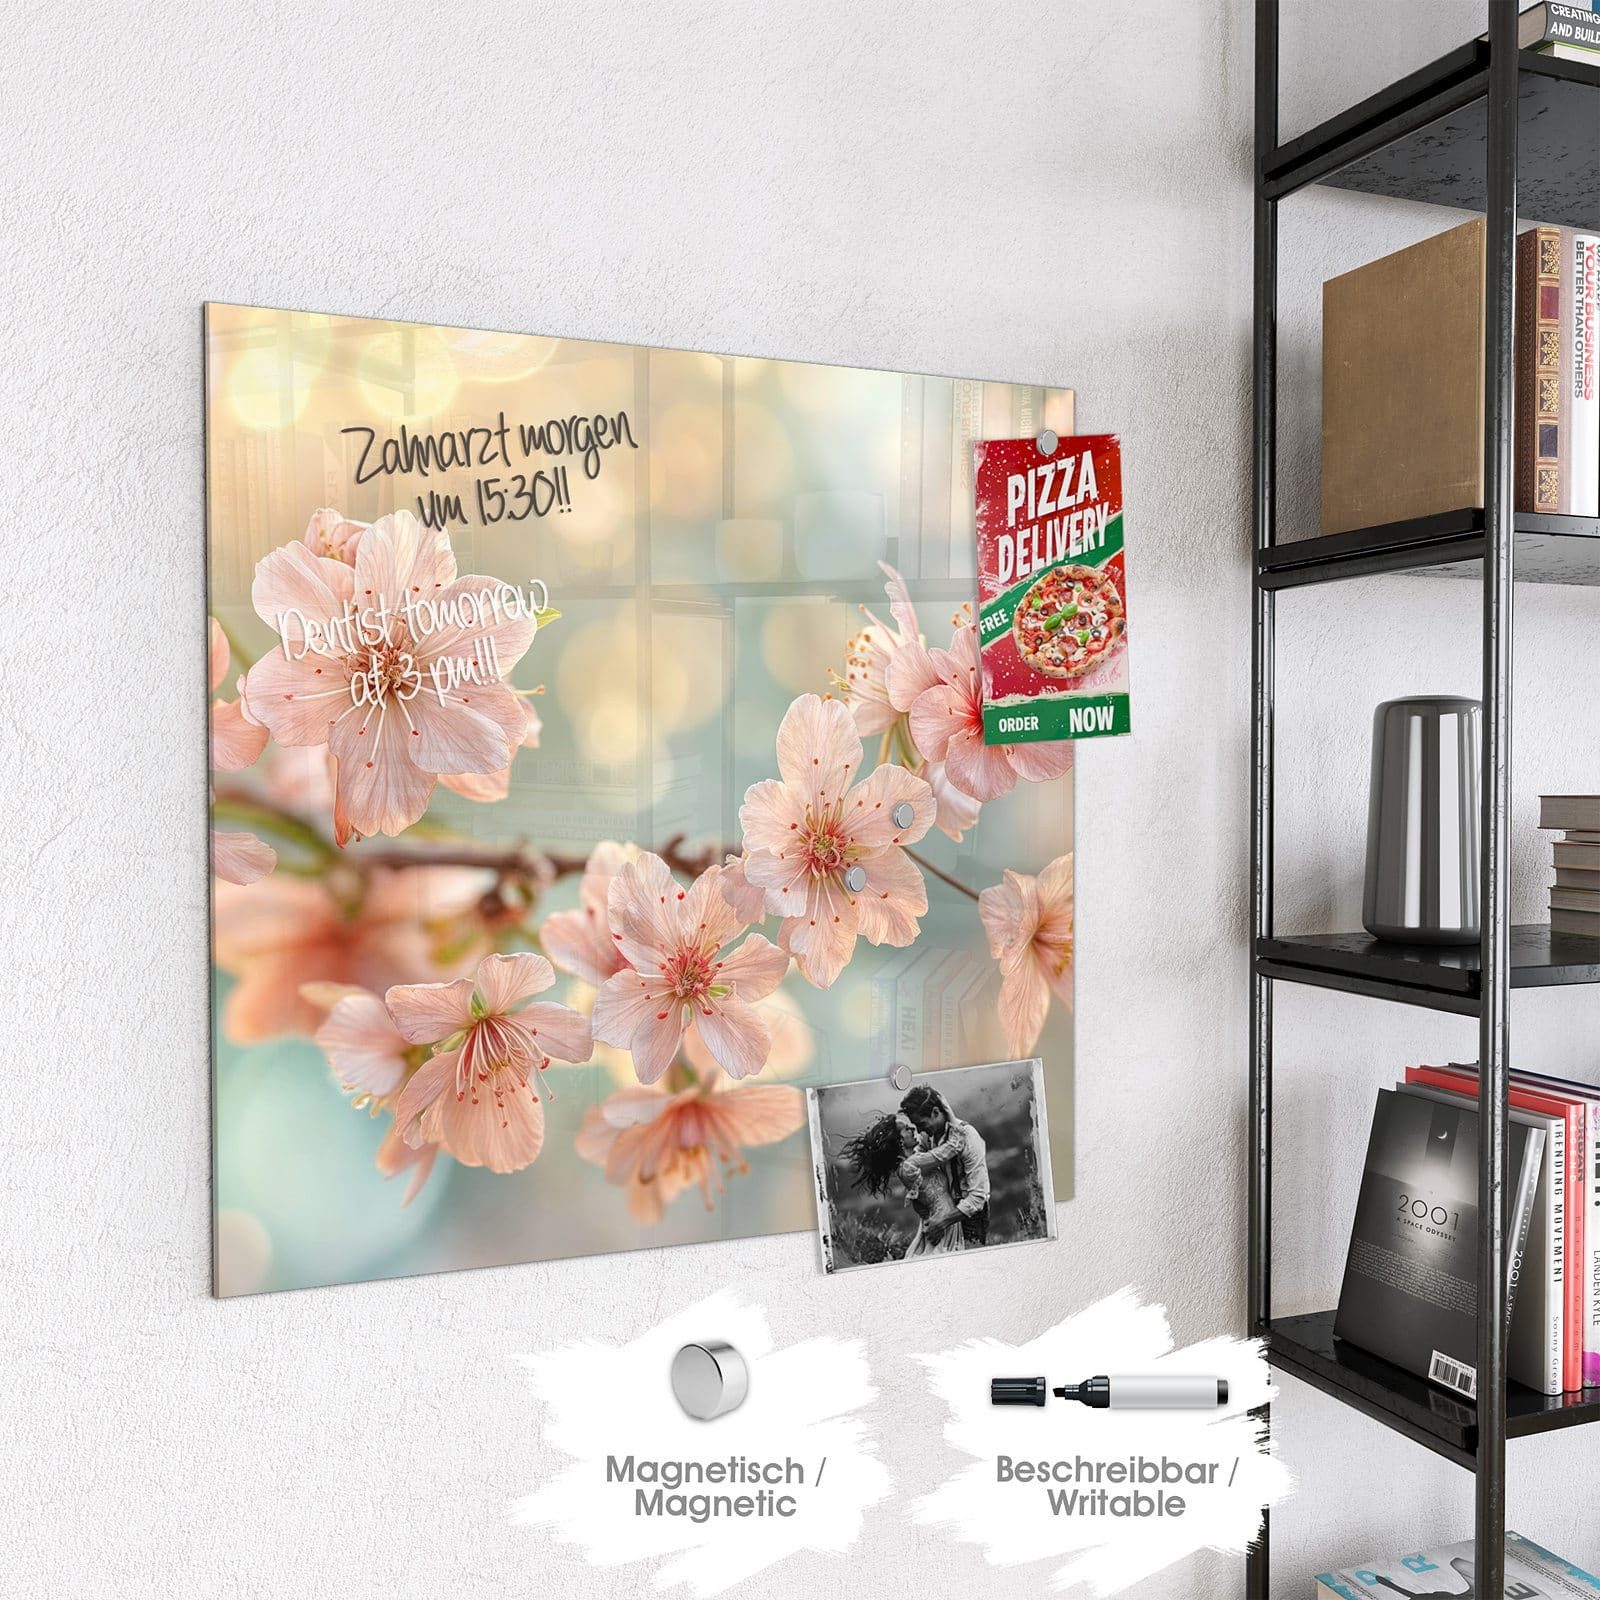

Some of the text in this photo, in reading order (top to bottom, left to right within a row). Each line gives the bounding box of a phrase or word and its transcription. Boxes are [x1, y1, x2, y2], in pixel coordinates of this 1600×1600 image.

[1550, 4, 1600, 24] CREATING
[1550, 22, 1573, 37] AND
[1574, 241, 1585, 399] BETTER THAN OTHERS
[1584, 243, 1596, 401] YOUR BUSINESS
[341, 411, 511, 484] Zahnarzt
[519, 411, 639, 480] morgen
[477, 465, 572, 526] 15:30!!
[1007, 450, 1098, 528] PIZZA
[998, 502, 1109, 584] DELIVERY
[276, 578, 549, 661] Dentist tomorrow
[980, 608, 1009, 636] FREE
[350, 635, 501, 711] at 3 pm!!!
[999, 705, 1115, 733] ORDER NOW
[1398, 1194, 1459, 1231] 2001
[1403, 1218, 1423, 1230] SPACE
[1425, 1226, 1456, 1241] ODYSSEY
[1553, 1123, 1564, 1283] TRENDING MOVEMENT
[1509, 1250, 1523, 1288] 2001
